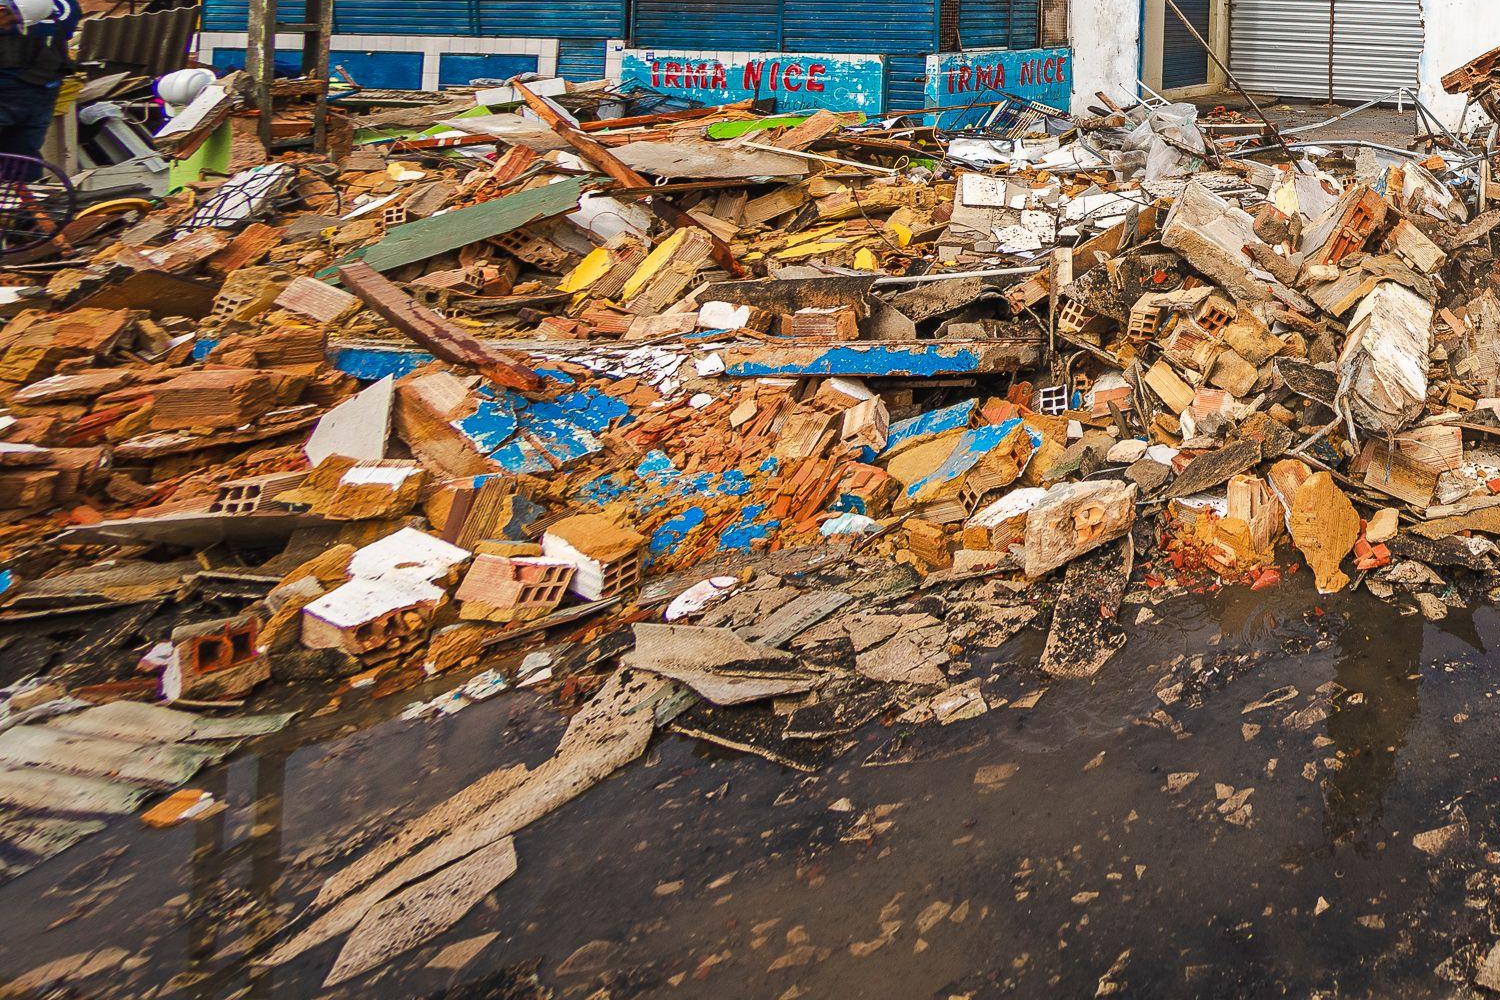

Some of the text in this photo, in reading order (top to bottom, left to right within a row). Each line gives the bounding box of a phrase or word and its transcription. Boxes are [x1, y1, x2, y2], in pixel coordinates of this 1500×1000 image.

[651, 61, 826, 92] IRMA NICE
[947, 57, 1067, 94] IRMA NICE
